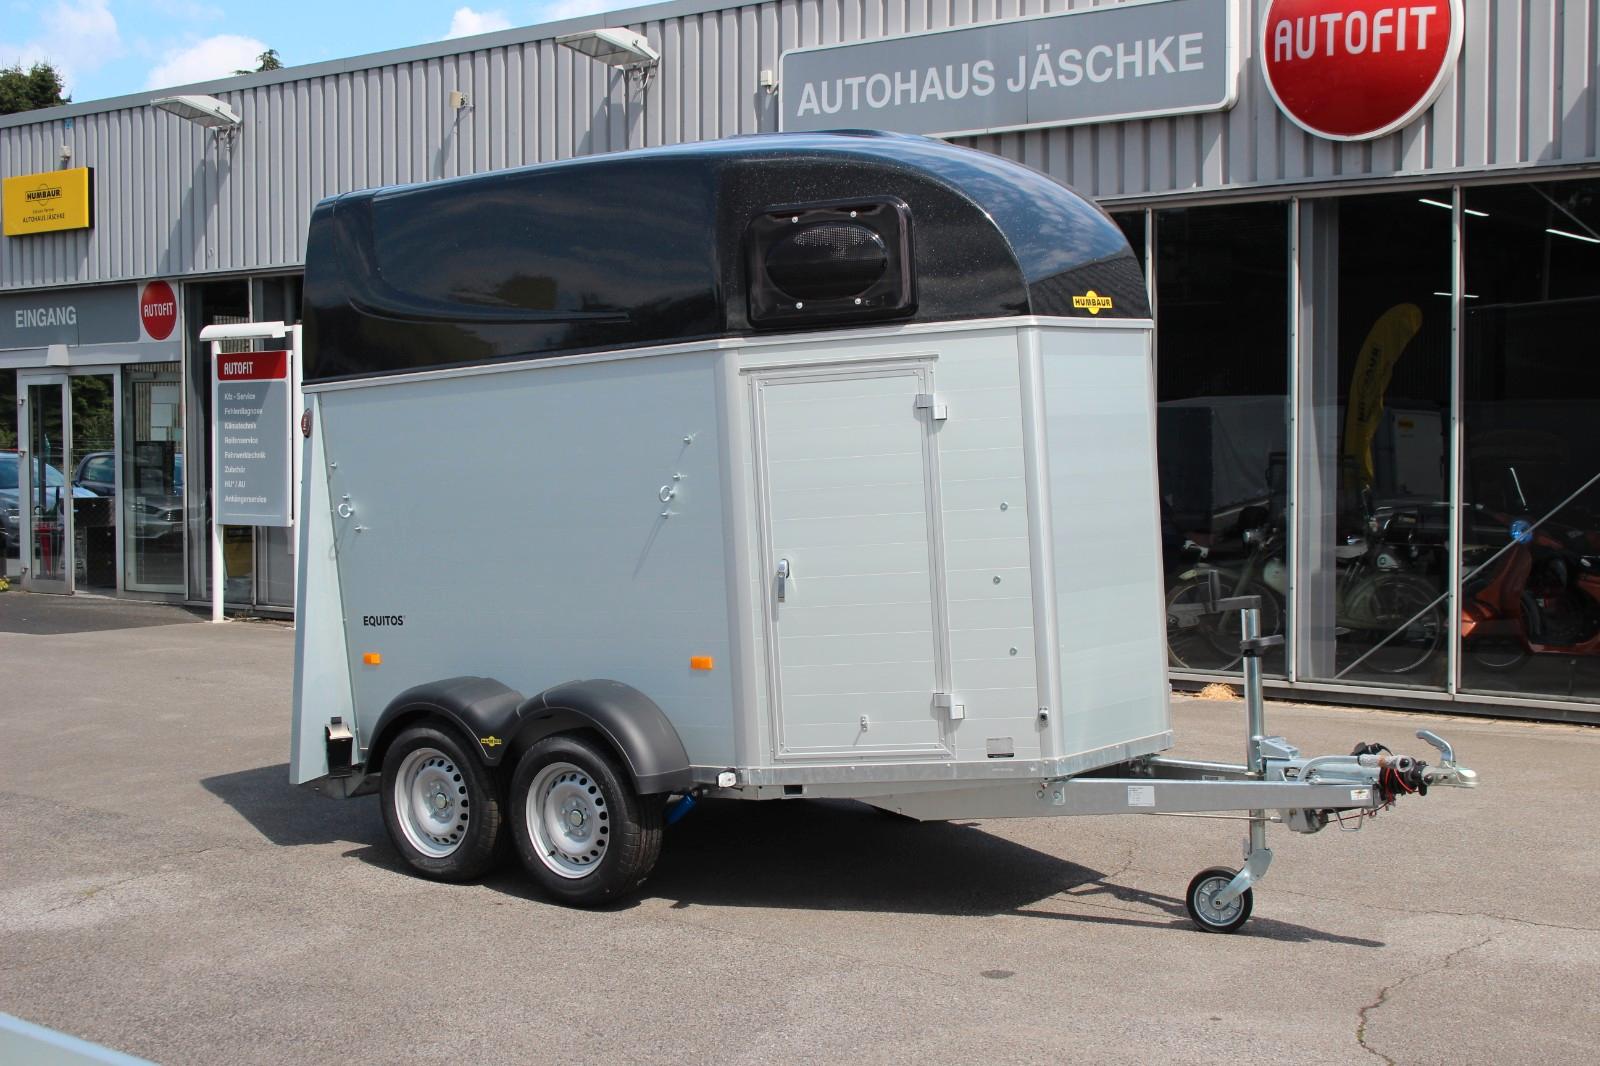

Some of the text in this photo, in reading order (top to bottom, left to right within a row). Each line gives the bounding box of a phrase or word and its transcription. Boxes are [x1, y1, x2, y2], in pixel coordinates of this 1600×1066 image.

[1274, 6, 1437, 63] AUTOFIT
[797, 32, 1204, 117] AUTOHAUS JÄSCHKE
[26, 189, 61, 200] HUMBAUR
[144, 302, 174, 318] AUTOFIT
[1074, 298, 1111, 307] HUMBAUR
[15, 306, 77, 328] EINGANG
[223, 362, 254, 376] AUTOFIT
[363, 615, 404, 627] EQUITOS
